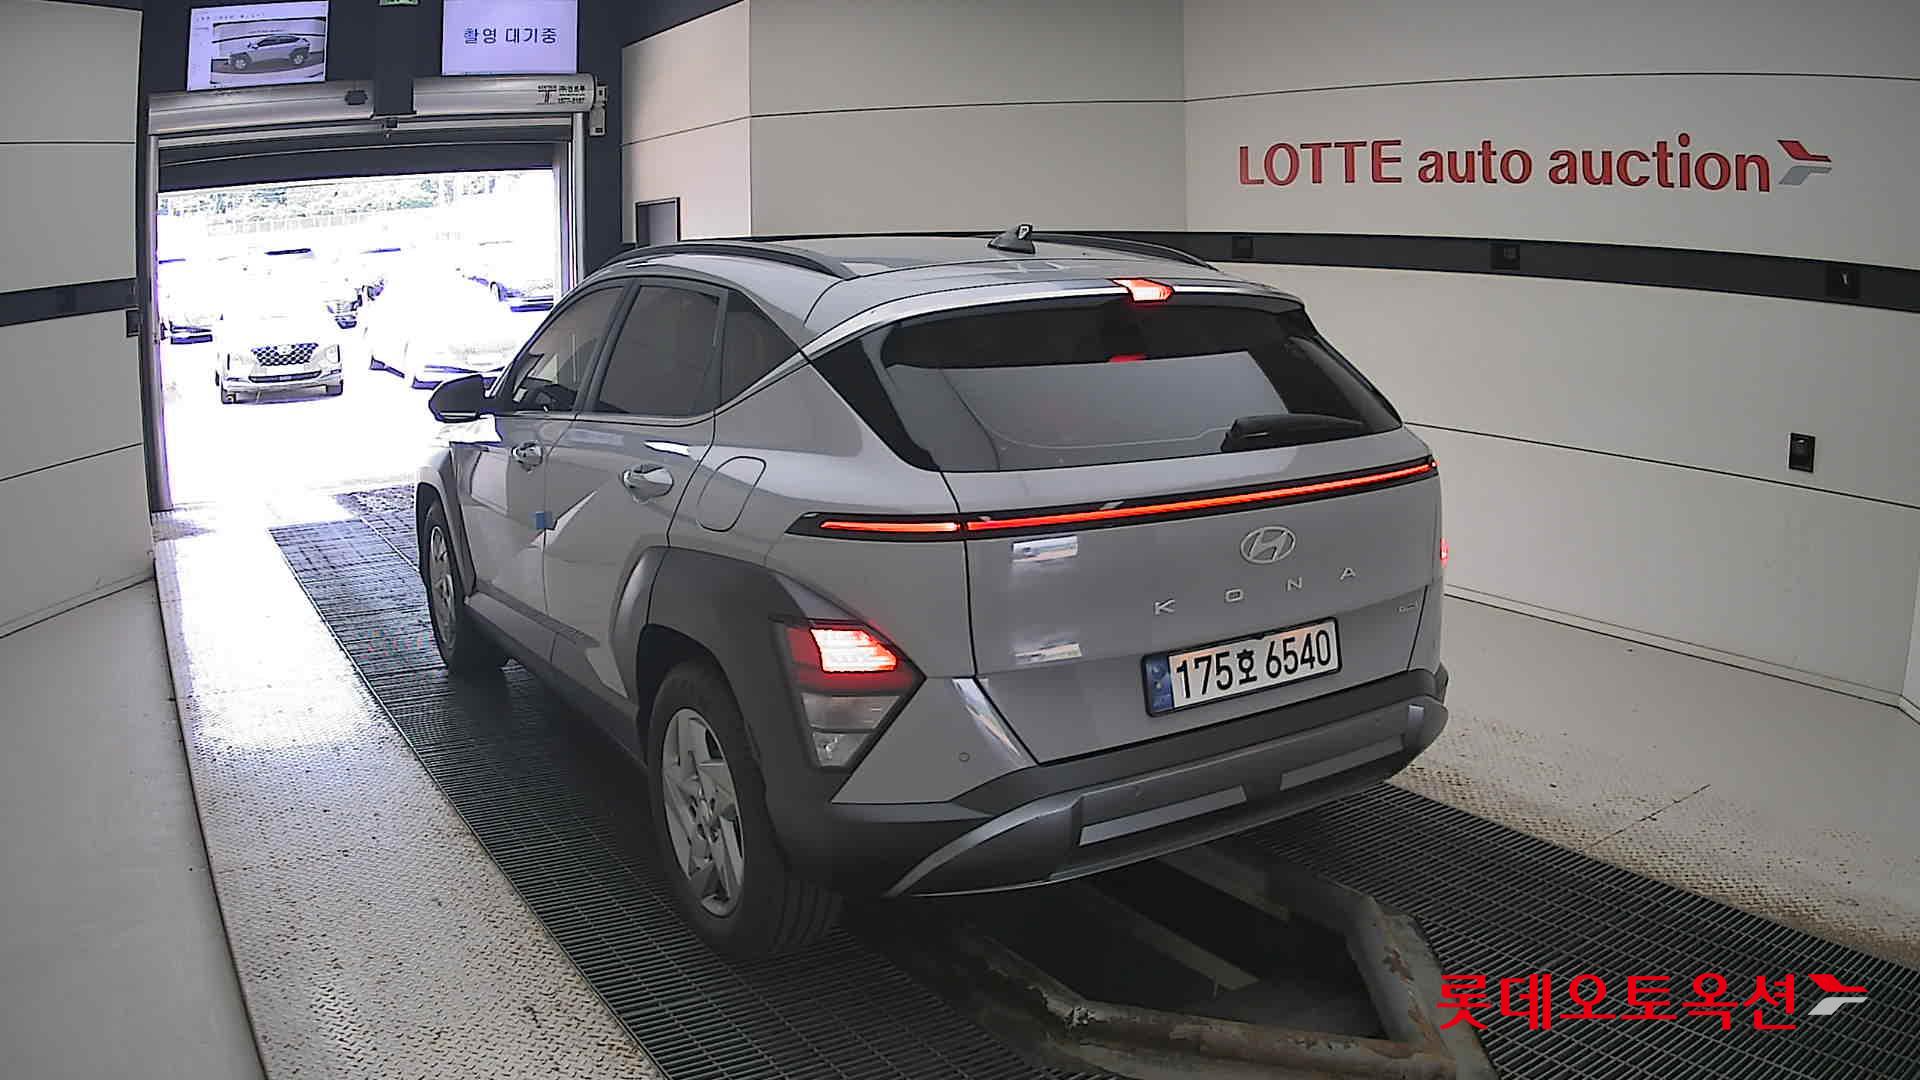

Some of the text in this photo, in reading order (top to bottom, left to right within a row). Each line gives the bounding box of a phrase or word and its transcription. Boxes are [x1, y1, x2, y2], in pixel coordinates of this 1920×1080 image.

[464, 28, 557, 44] 촬영 대기중
[1238, 132, 1771, 193] LOTTE auto auction
[1154, 567, 1357, 615] KONA
[1175, 629, 1332, 700] 175호 6540
